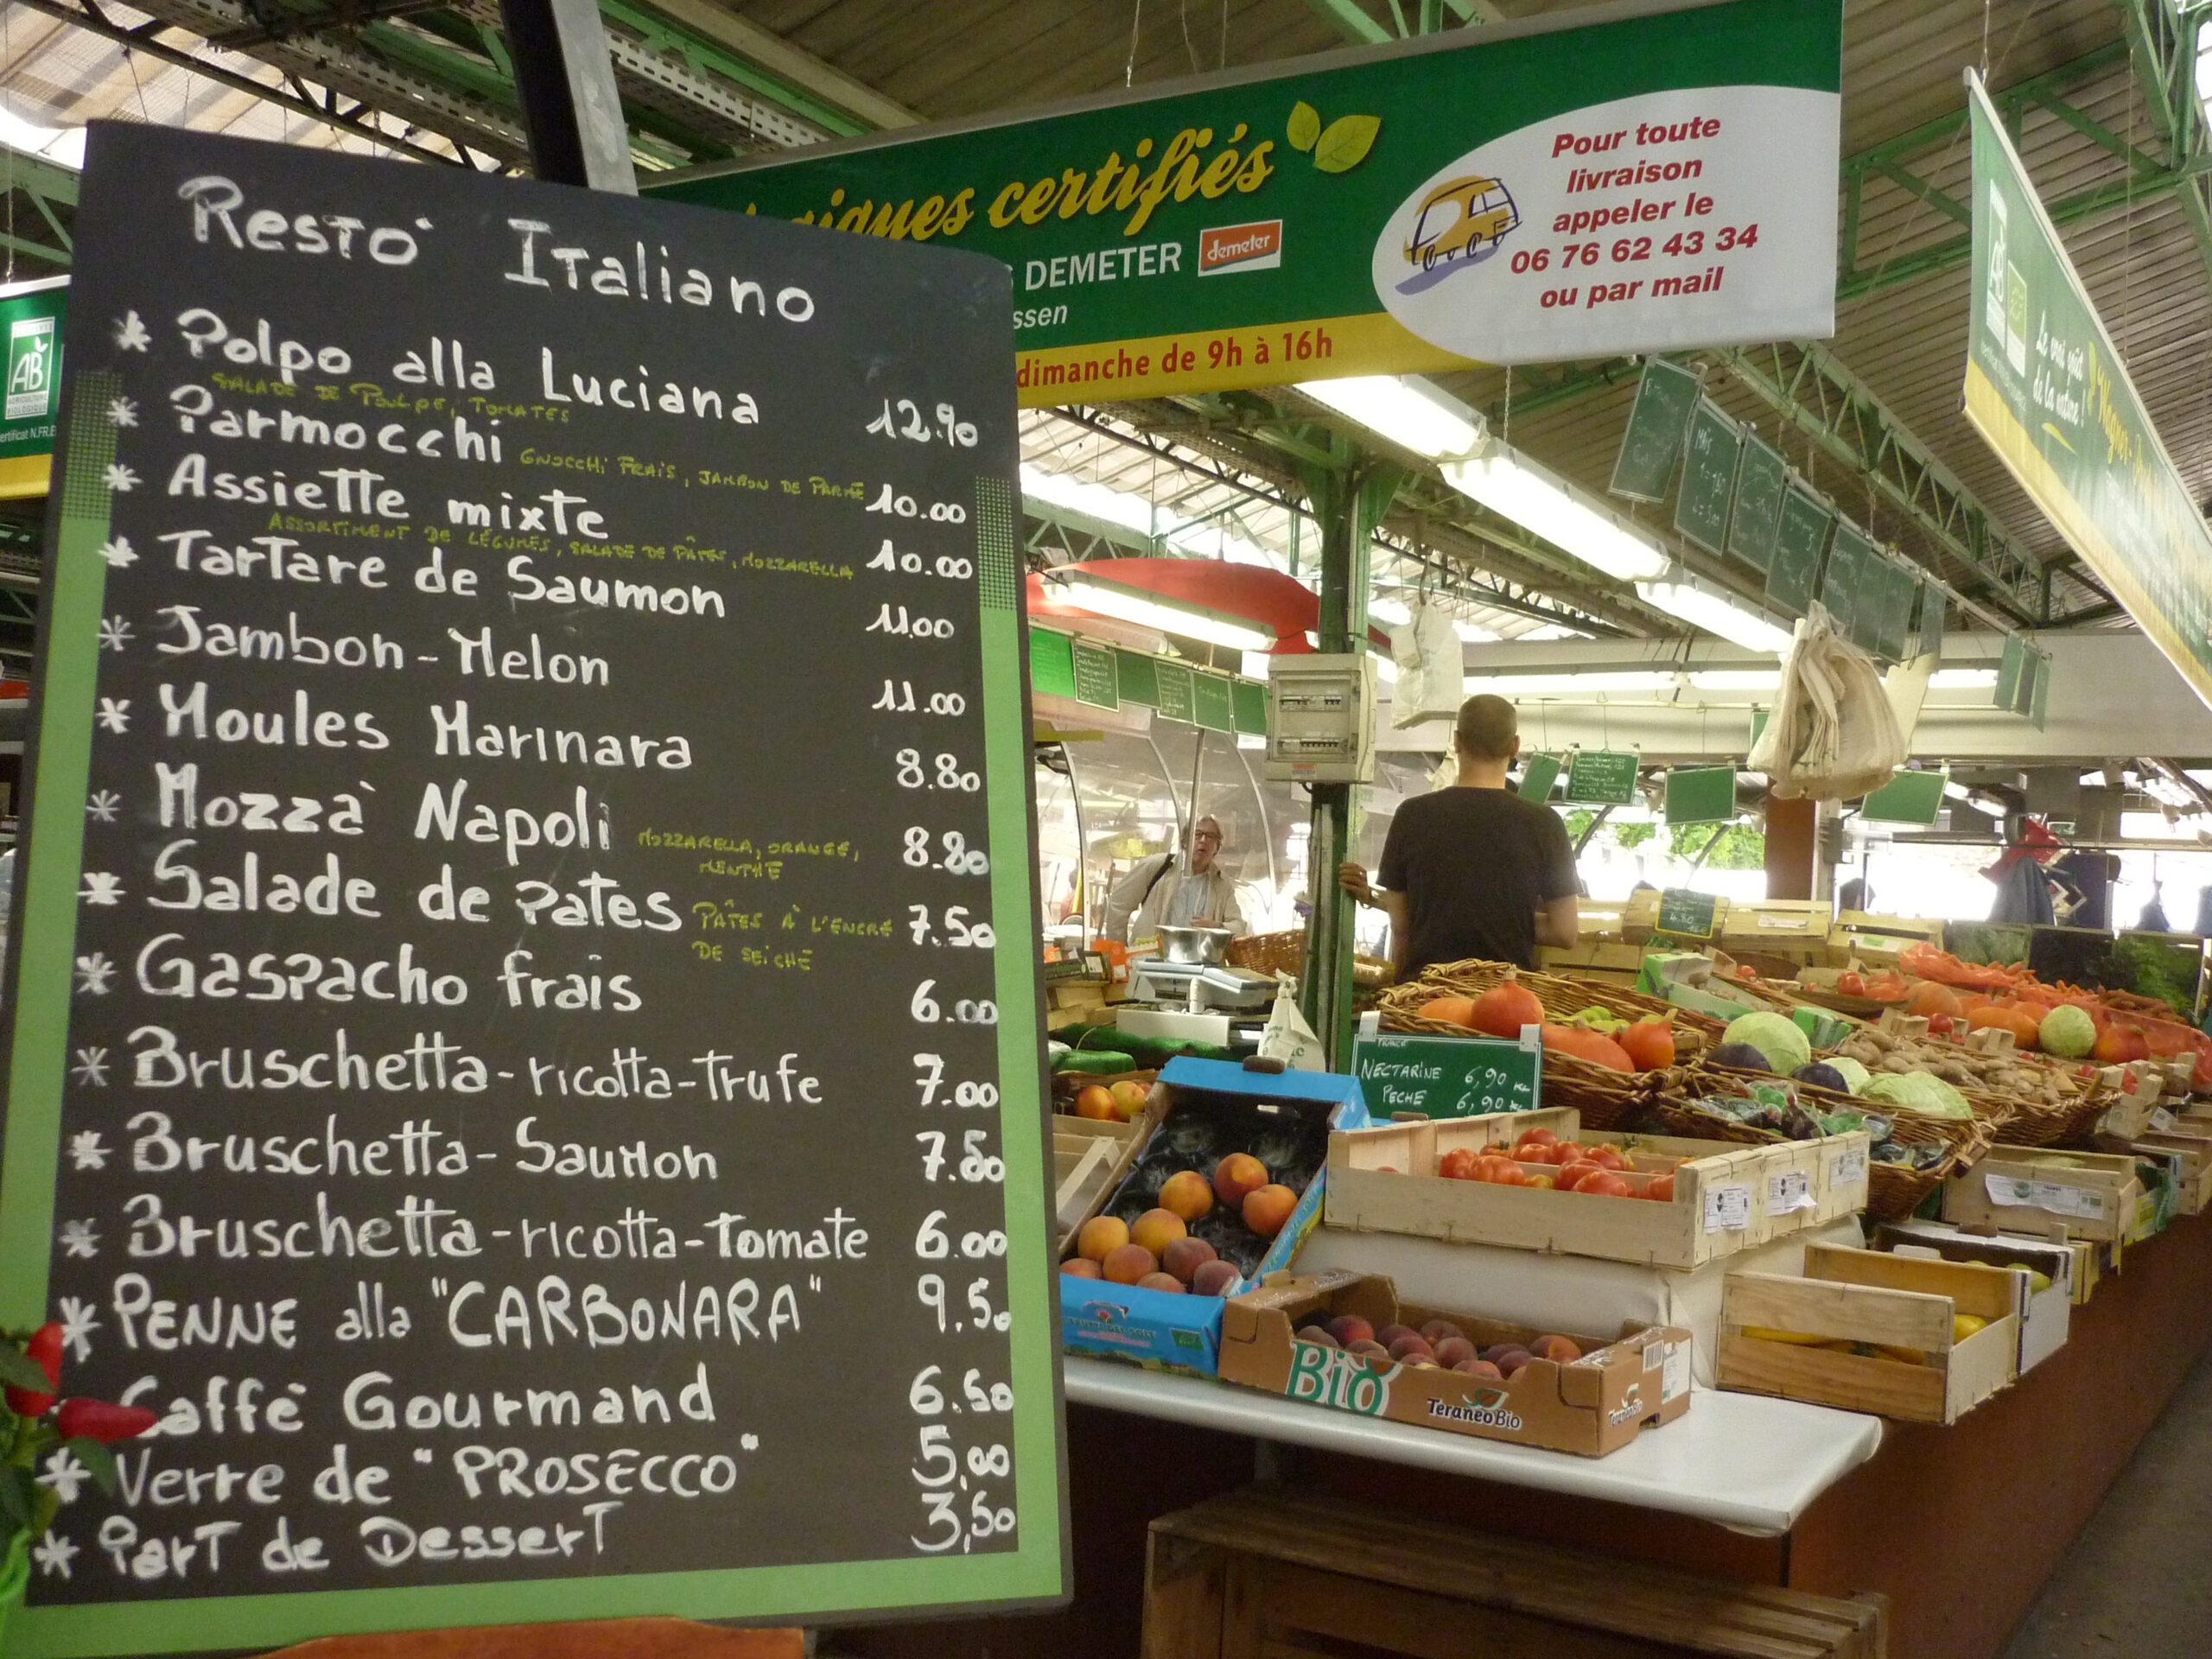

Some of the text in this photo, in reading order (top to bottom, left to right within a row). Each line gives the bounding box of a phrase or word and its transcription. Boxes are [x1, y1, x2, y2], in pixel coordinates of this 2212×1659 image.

[1552, 115, 1720, 158] Pour toute
[988, 123, 1276, 236] certifiés
[1566, 158, 1702, 194] livraison
[1552, 192, 1714, 233] appeler le
[1024, 241, 1183, 292] DEMETER
[1206, 232, 1272, 262] demeter
[1510, 223, 1758, 274] 06 76 62 43 34
[1540, 266, 1723, 309] ou par mail
[10, 352, 43, 393] AB
[177, 308, 760, 423] Polpo alla Luciana
[1016, 327, 1333, 390] dimanche de 9h à 16h
[170, 385, 502, 464] Parmocchi
[866, 398, 978, 448] 12.90
[448, 489, 608, 540] mixte
[866, 483, 966, 524] 10.00
[415, 546, 478, 597] de
[506, 555, 725, 618] Saumon
[866, 539, 973, 580] 10.00
[865, 603, 954, 639] 11.00
[871, 679, 965, 717] 11.00
[159, 681, 692, 769] Moules Marinara
[895, 748, 980, 792] 8.80
[414, 778, 610, 867] Napoli
[903, 826, 989, 875] 8.80
[146, 838, 381, 918] Salade
[418, 864, 491, 924] de
[909, 904, 997, 949] 7.50
[136, 933, 642, 1012] Gaspacho frais
[911, 978, 999, 1024] 6.00
[913, 1053, 1000, 1108] 7.00
[1361, 1058, 1442, 1080] NECTARINE
[1382, 1084, 1427, 1105] PECHE
[916, 1128, 1006, 1183] 7.50
[915, 1210, 1008, 1260] 6.00
[335, 1281, 413, 1342] alla
[917, 1274, 1012, 1333] 9.50
[342, 1361, 716, 1429] Gourmand
[910, 1365, 1014, 1415] 6.50
[117, 1447, 285, 1507] Verre
[314, 1443, 391, 1504] de
[262, 1516, 330, 1572] de
